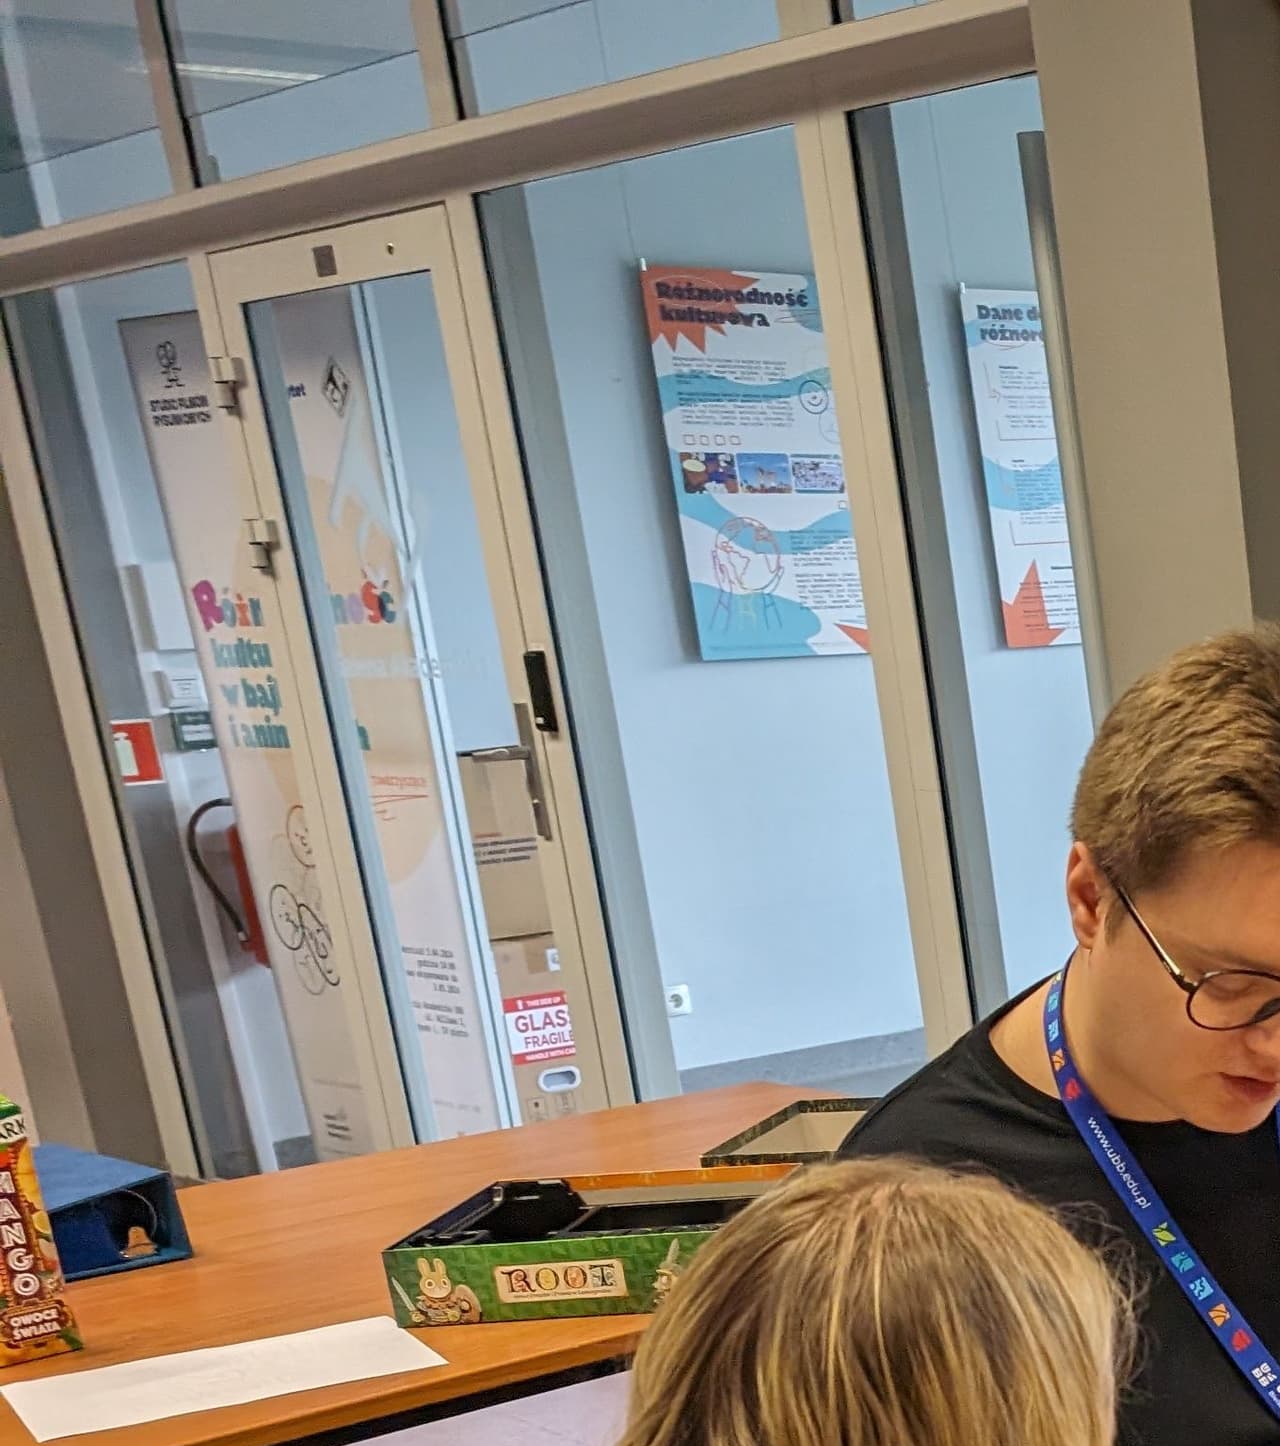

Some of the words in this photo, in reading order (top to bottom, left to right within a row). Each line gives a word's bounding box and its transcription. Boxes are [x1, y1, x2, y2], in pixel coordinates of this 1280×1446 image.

[655, 281, 809, 308] Różnorodność
[660, 304, 770, 328] kulturowa
[976, 304, 1024, 321] Dane
[1026, 305, 1041, 321] d
[980, 323, 1043, 341] różnor
[514, 1009, 570, 1033] GLAS
[0, 1118, 26, 1144] ARK
[1088, 1116, 1151, 1209] www.ubb.edu.pl
[500, 1262, 616, 1293] ROOT
[10, 1308, 59, 1328] OWOCE
[13, 1321, 61, 1342] ŚWIATA
